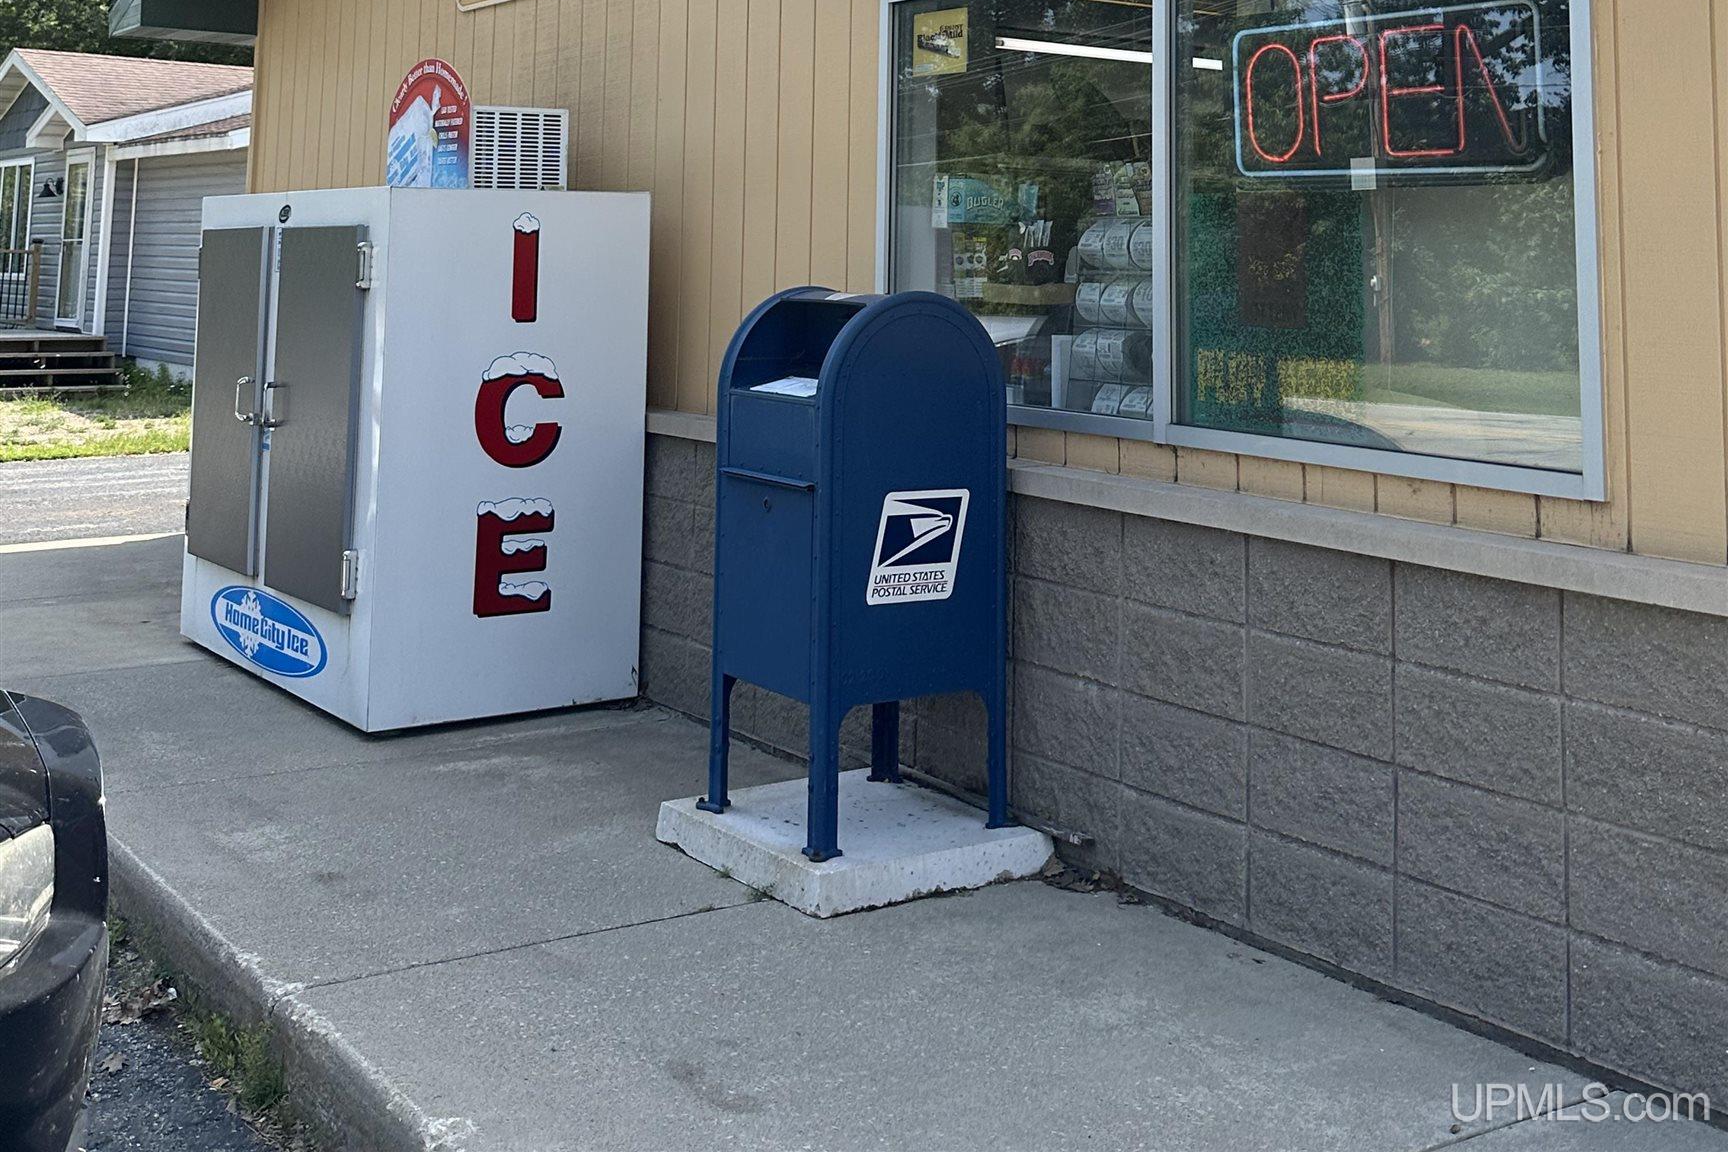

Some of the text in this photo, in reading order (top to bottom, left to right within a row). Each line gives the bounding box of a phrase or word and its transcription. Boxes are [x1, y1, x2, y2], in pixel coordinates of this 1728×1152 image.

[1246, 23, 1527, 164] OPEN
[967, 196, 1003, 211] BUGLER
[473, 212, 565, 619] ICE
[872, 582, 948, 598] POSTAL SERVICE
[874, 570, 945, 584] UNITED STATES
[225, 602, 309, 656] Home City Ice
